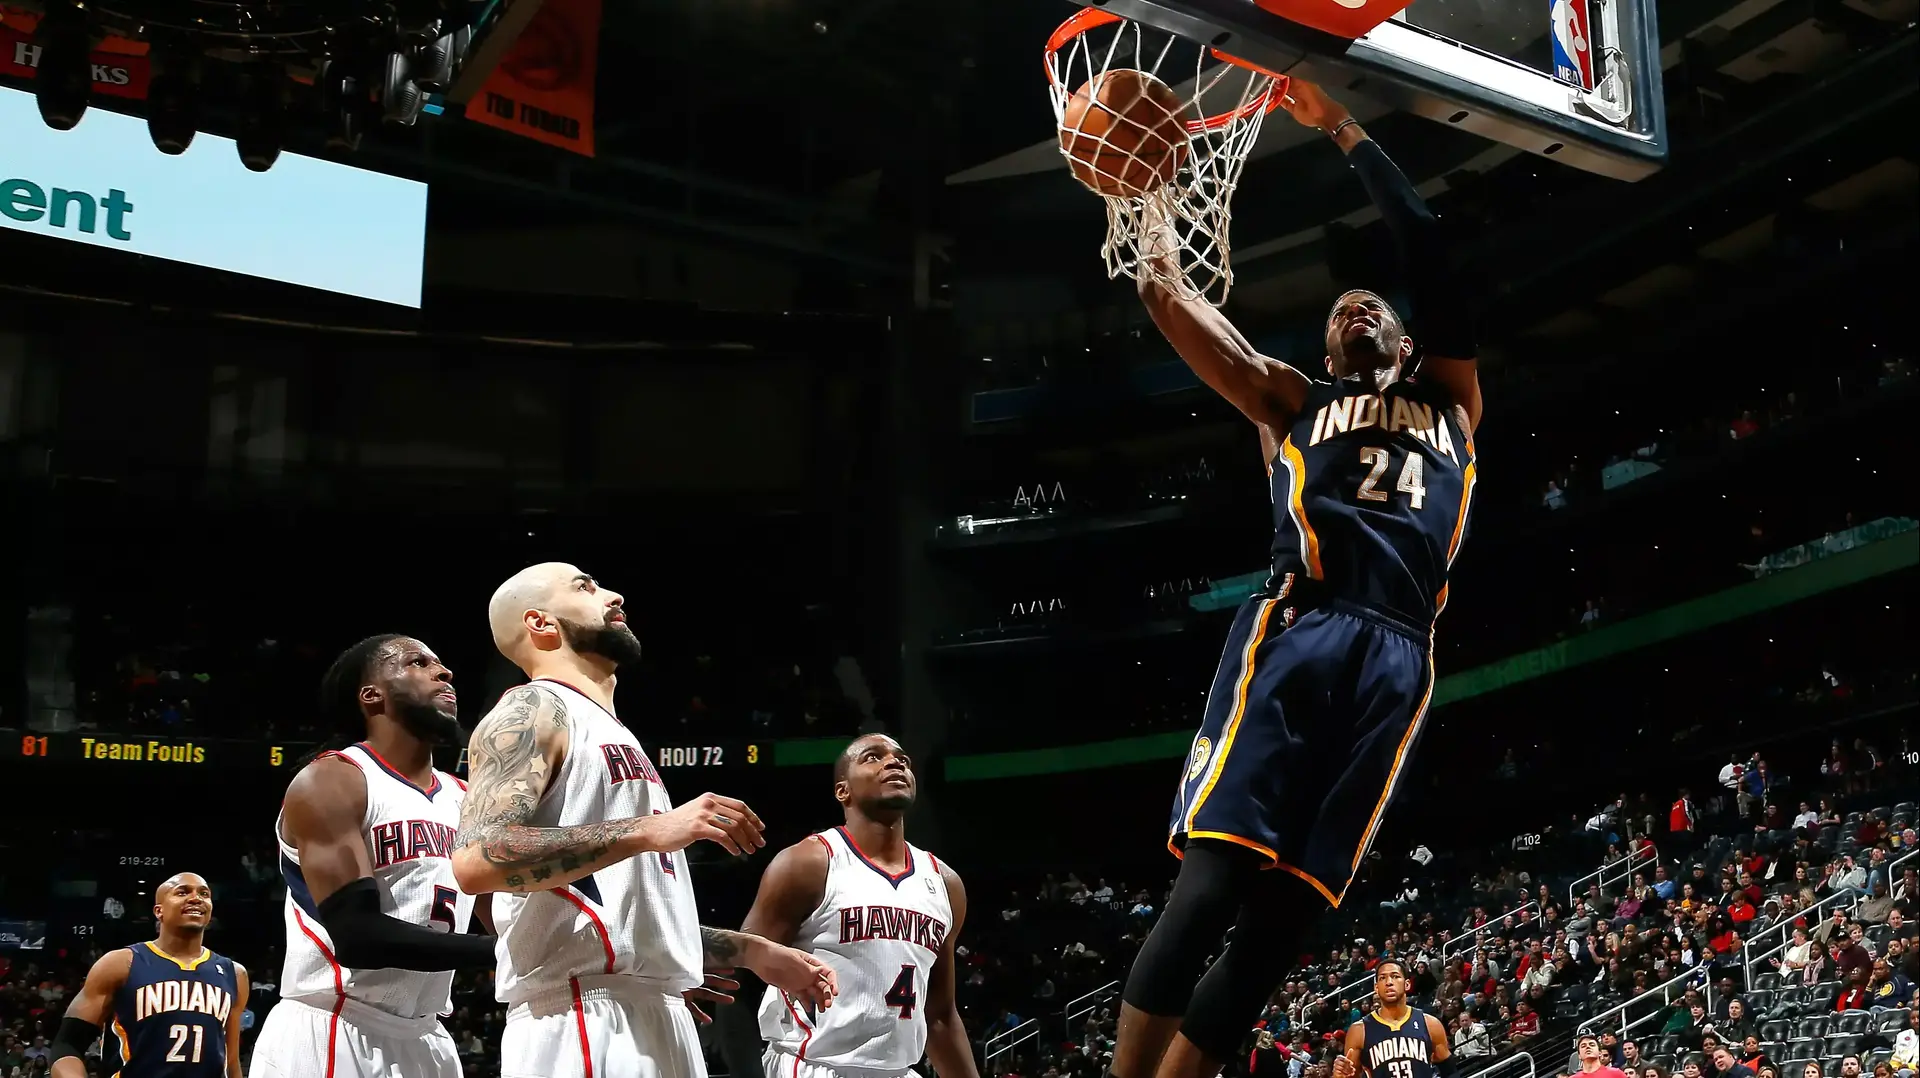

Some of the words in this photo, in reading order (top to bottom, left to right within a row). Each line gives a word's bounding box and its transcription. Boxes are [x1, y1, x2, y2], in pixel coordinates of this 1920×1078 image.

[13, 41, 129, 85] HKS
[1557, 65, 1580, 85] NBA
[0, 177, 133, 241] ent
[1309, 394, 1459, 468] INDIANA
[1357, 446, 1426, 510] 24
[21, 735, 48, 756] 81
[81, 738, 142, 761] Team
[148, 741, 205, 763] Fouls
[270, 746, 283, 766] 5
[660, 748, 697, 767] HOU
[702, 746, 723, 766] 72
[747, 744, 758, 764] 3
[600, 744, 661, 786] HAW
[372, 819, 458, 869] HAW
[1523, 834, 1541, 846] 102
[119, 856, 165, 866] 219-221
[428, 885, 458, 933] 5
[1108, 901, 1124, 911] 101
[72, 925, 94, 935] 121
[839, 905, 946, 956] HAWKS
[136, 980, 231, 1027] INDIANA
[884, 964, 917, 1020] 4
[166, 1024, 203, 1062] 21
[1368, 1036, 1429, 1070] INDIANA
[1388, 1060, 1413, 1078] 33
